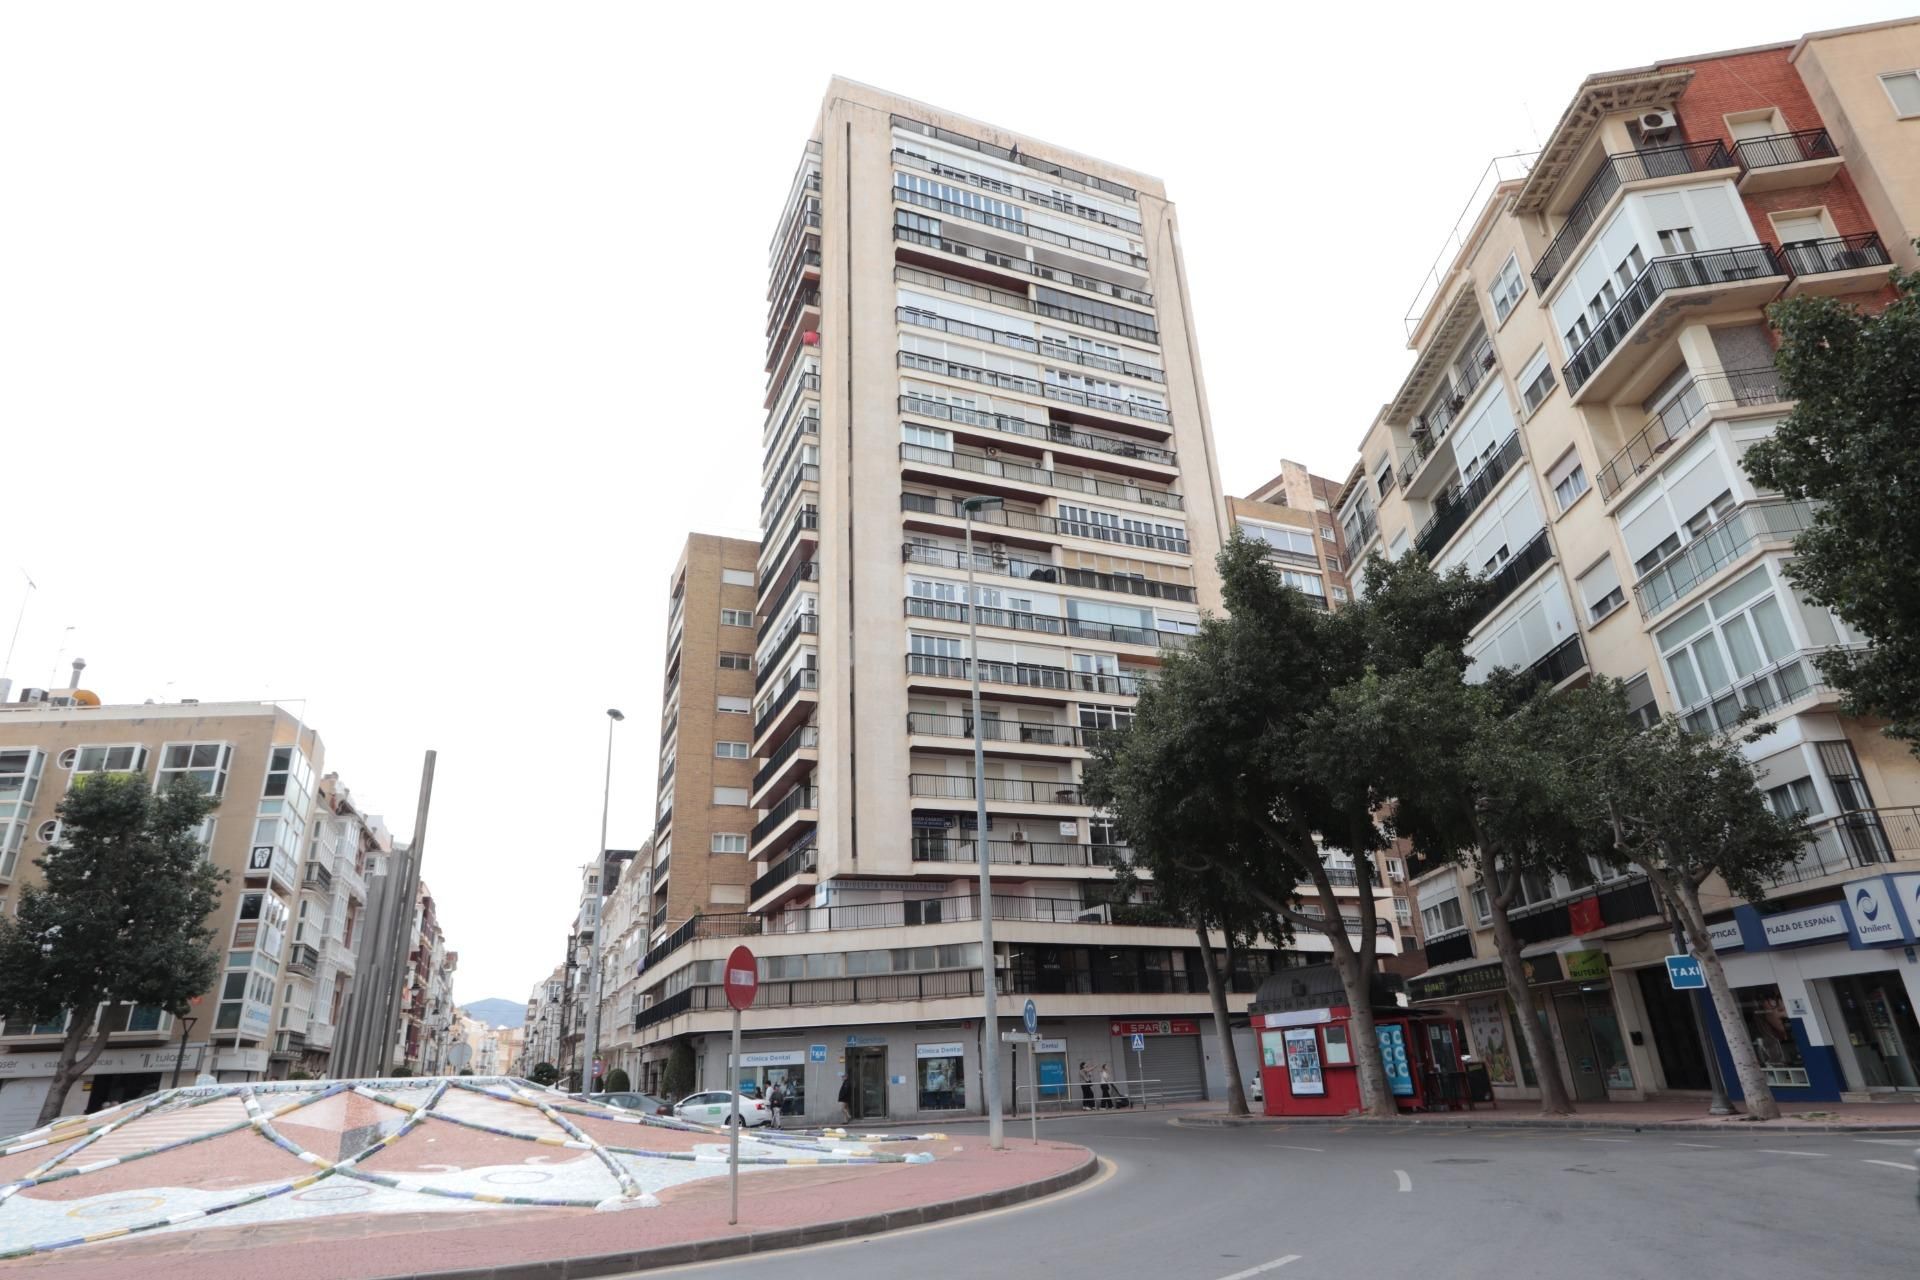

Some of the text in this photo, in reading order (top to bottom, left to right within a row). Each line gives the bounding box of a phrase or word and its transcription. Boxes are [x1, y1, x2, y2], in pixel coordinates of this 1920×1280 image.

[1766, 914, 1836, 935] PLAZA DE ESPAÑA
[1859, 922, 1892, 934] Unilent
[1710, 927, 1737, 940] PTICAS
[1671, 966, 1701, 977] TAXI
[1130, 1023, 1160, 1032] SPAR
